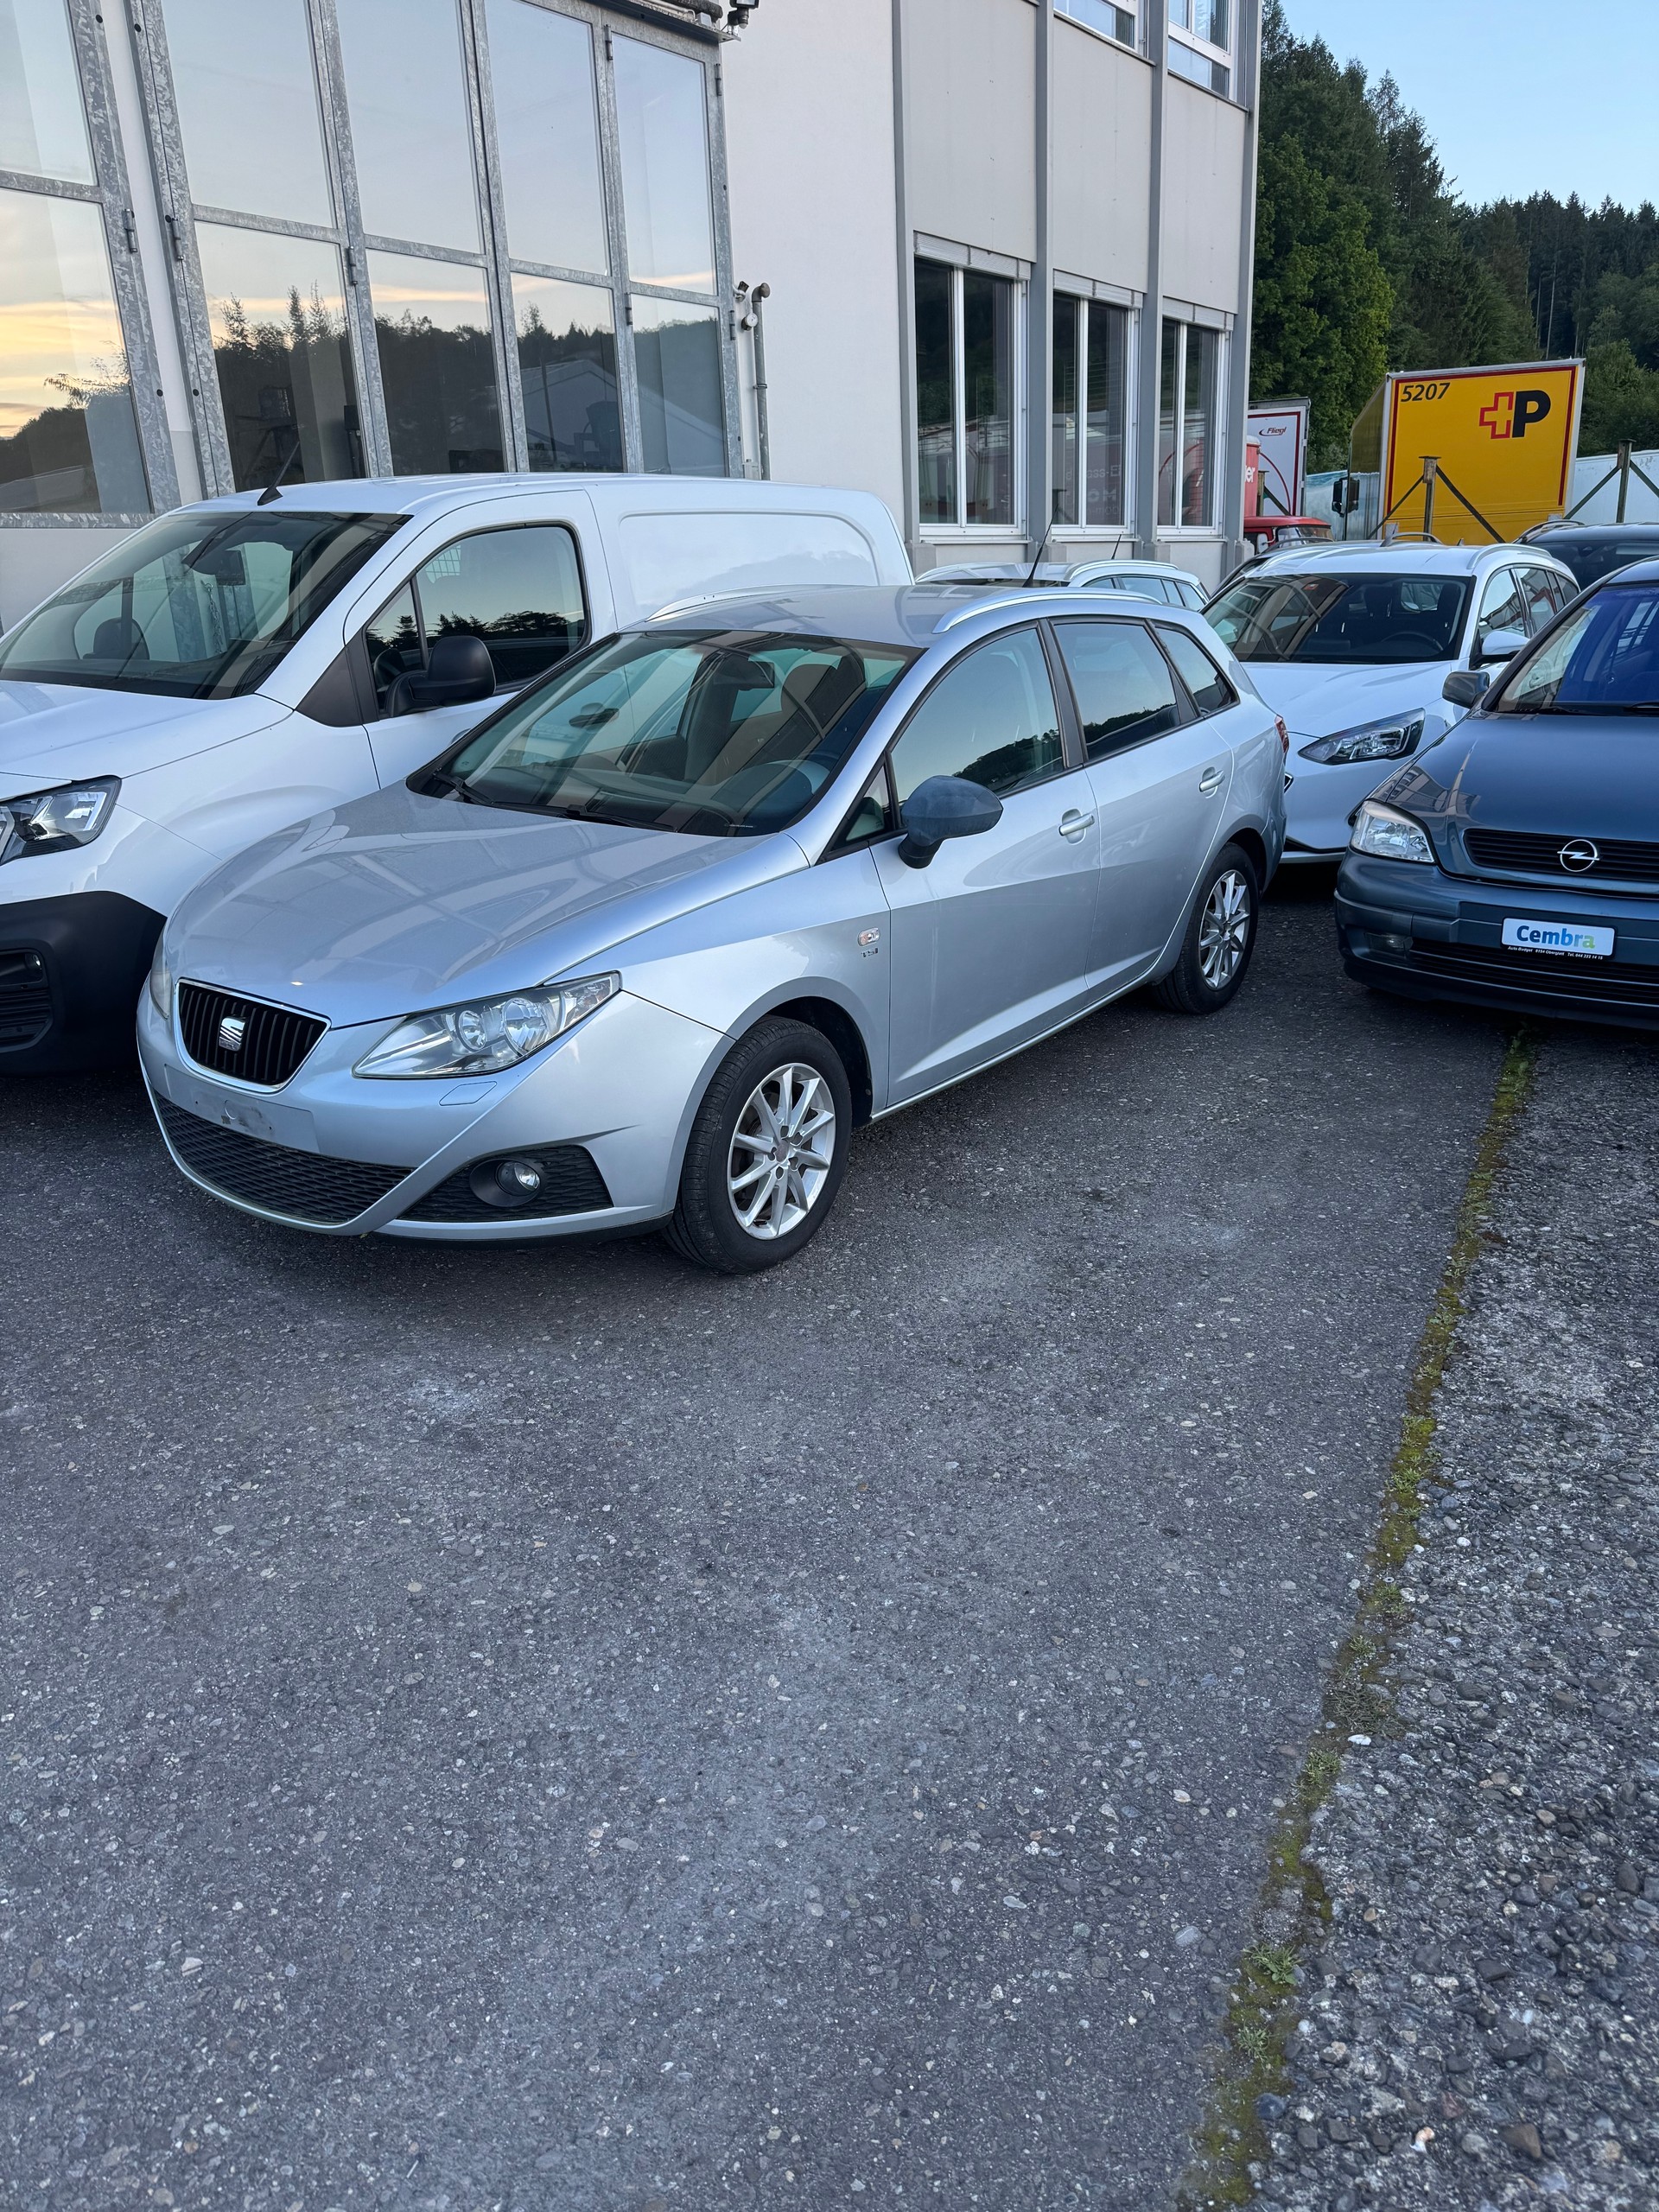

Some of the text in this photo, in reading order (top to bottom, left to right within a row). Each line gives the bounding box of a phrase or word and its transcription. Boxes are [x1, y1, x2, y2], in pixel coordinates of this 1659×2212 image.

[1400, 382, 1451, 402] 5207
[1511, 390, 1551, 438] P
[1267, 427, 1287, 435] Fliegl
[1516, 925, 1596, 949] Cembra
